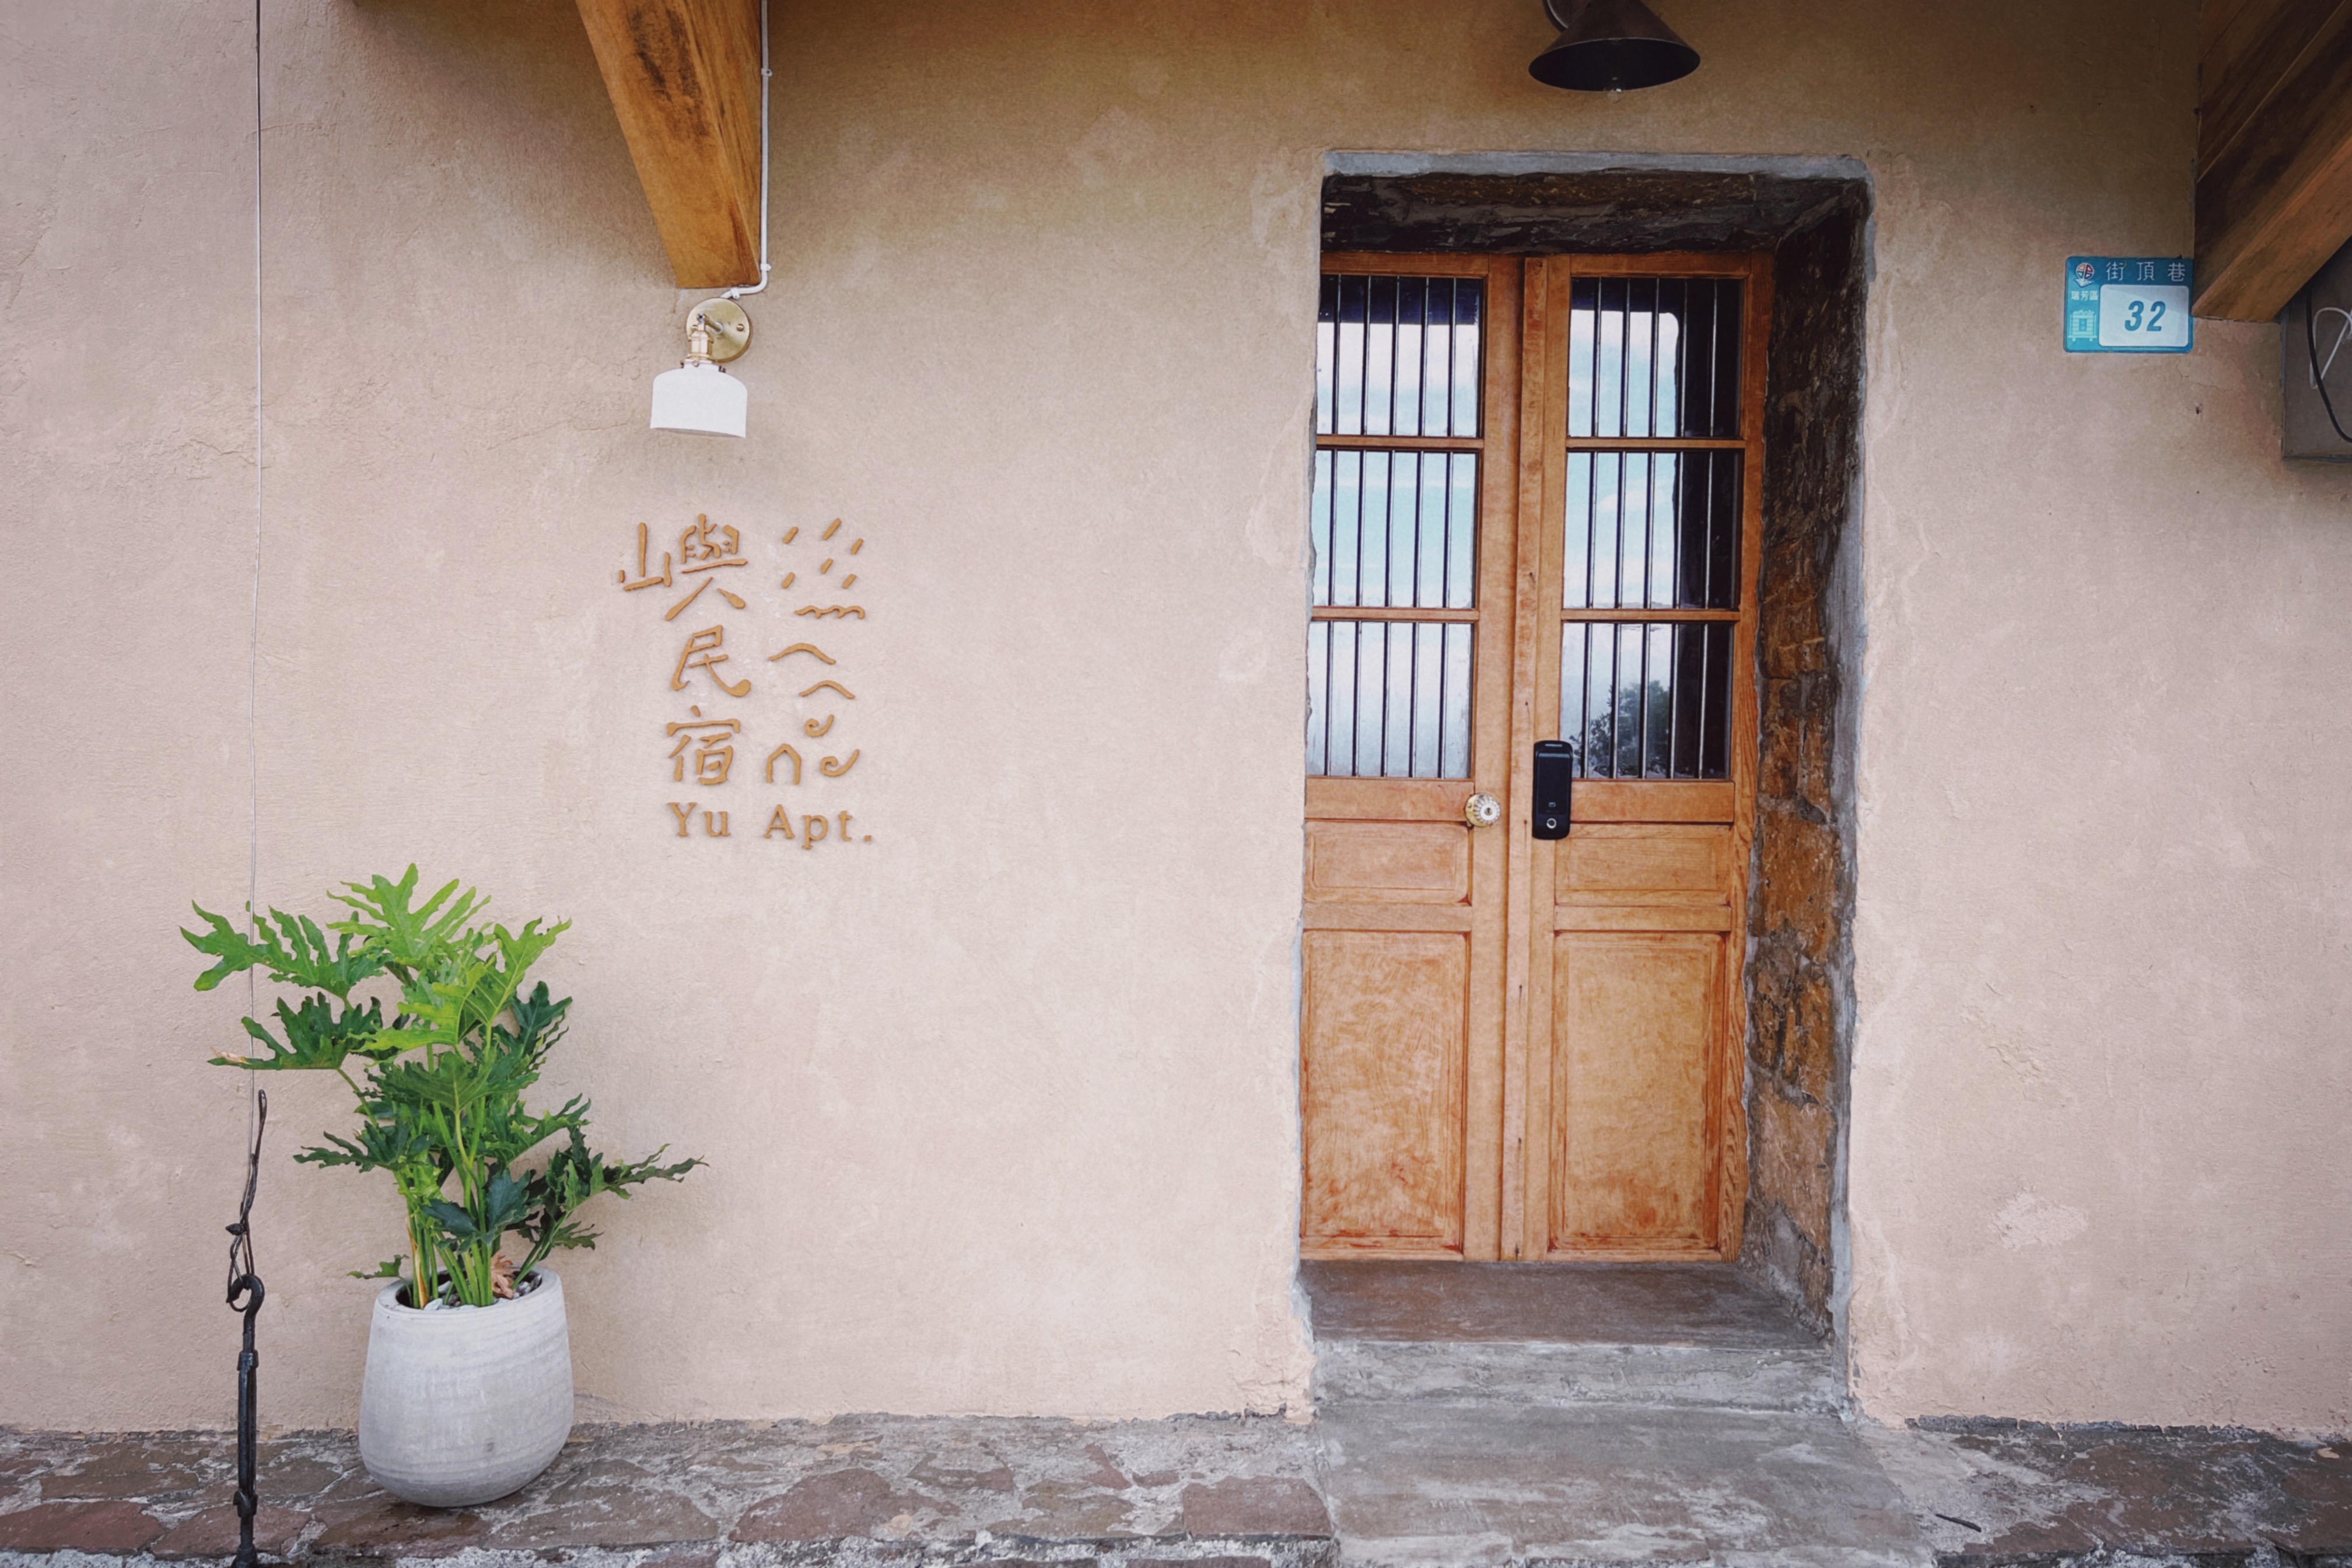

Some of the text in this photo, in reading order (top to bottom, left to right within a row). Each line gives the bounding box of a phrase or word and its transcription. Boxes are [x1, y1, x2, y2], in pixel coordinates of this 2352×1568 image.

[2106, 261, 2186, 281] 街頂巷
[2124, 300, 2166, 331] 32
[618, 513, 751, 786] 嶼民宿
[668, 802, 872, 850] Yu Apt.
